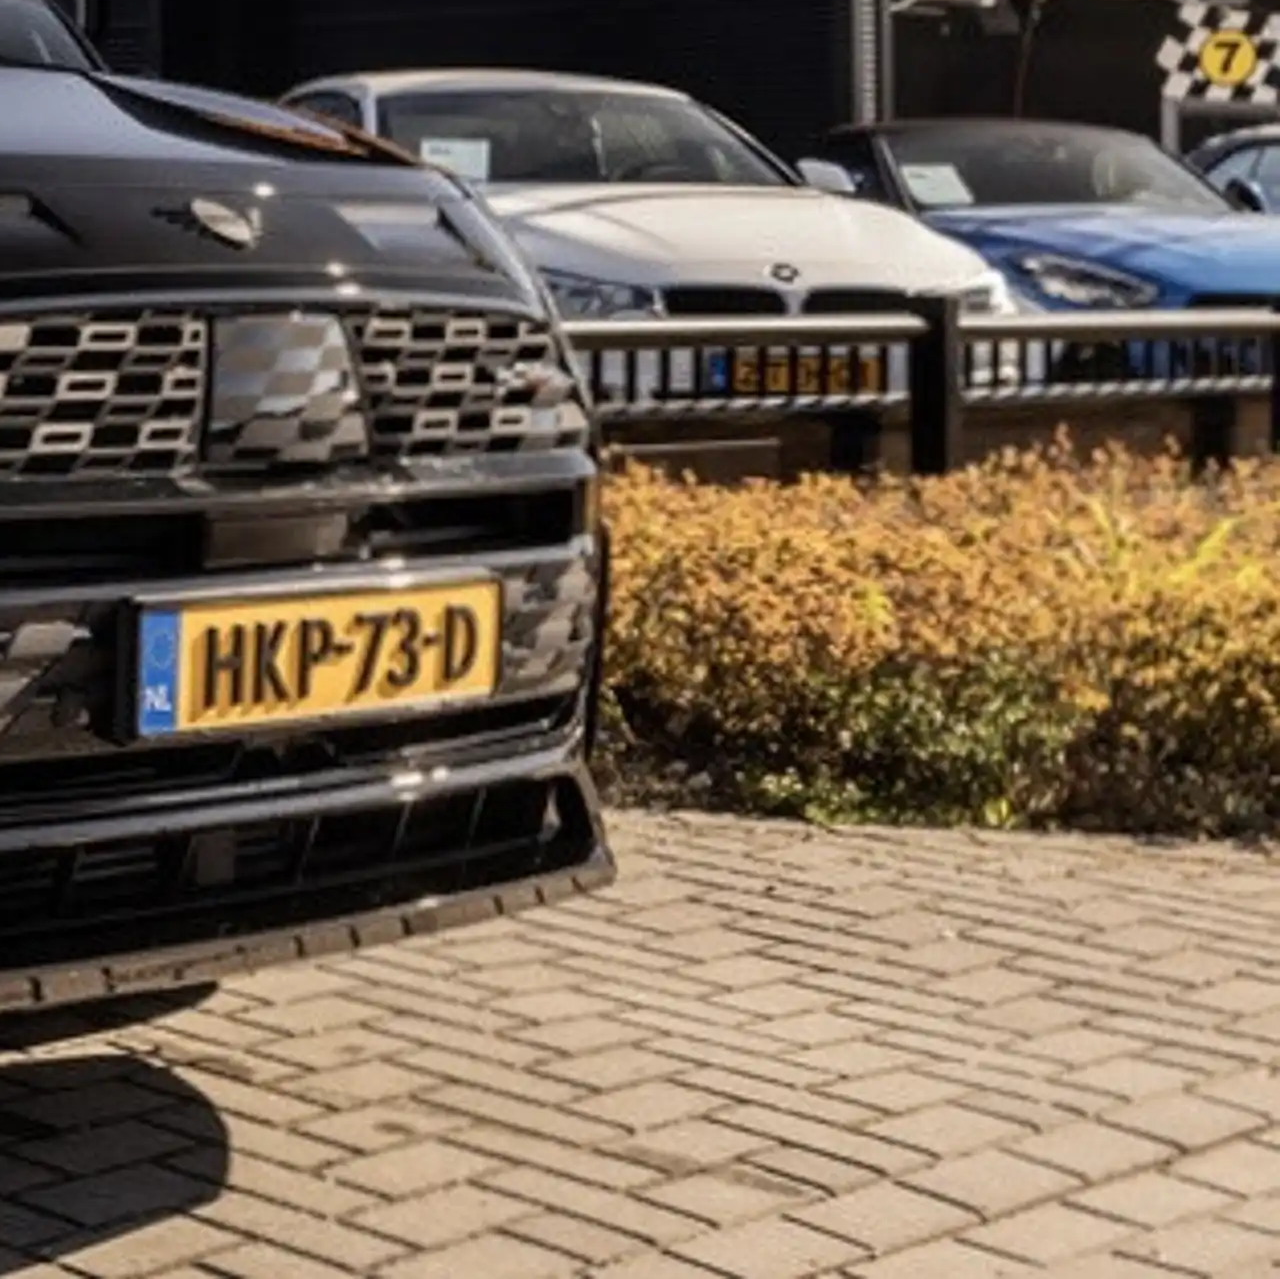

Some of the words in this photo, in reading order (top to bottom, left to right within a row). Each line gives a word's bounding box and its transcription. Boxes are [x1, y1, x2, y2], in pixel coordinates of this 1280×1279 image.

[1213, 41, 1243, 75] 7
[203, 603, 479, 711] HKP-73-D
[143, 685, 172, 712] NL
